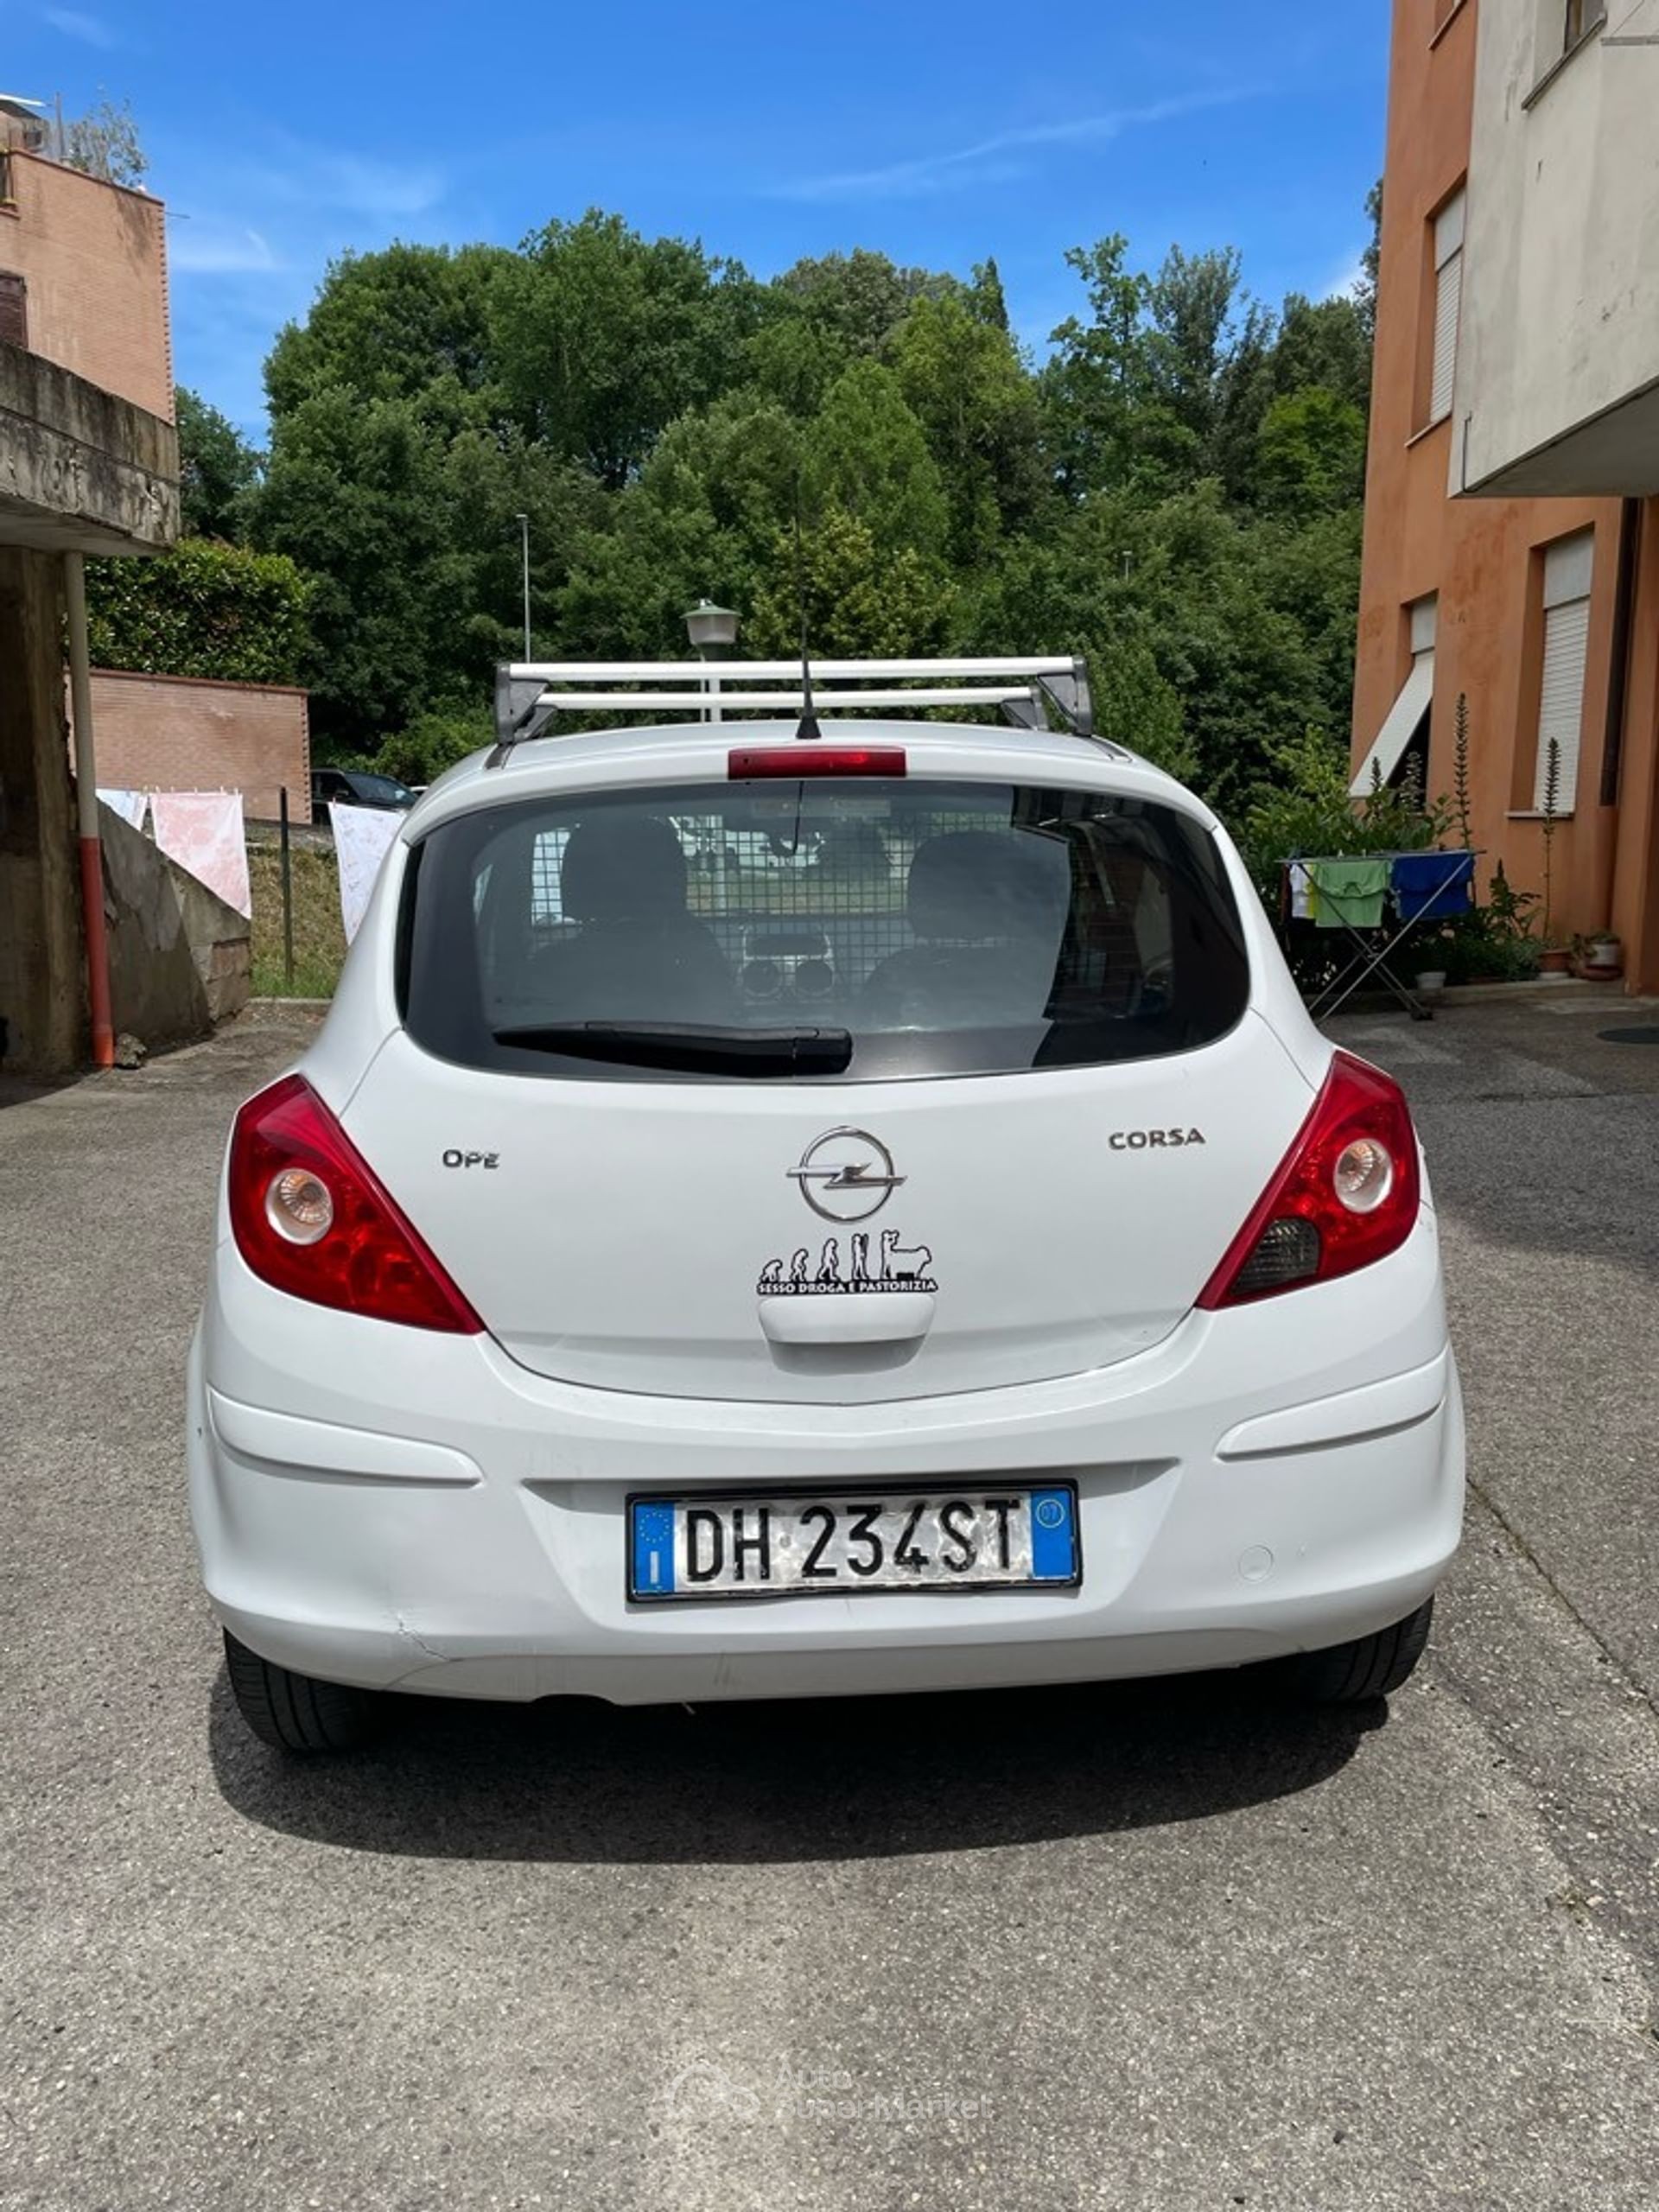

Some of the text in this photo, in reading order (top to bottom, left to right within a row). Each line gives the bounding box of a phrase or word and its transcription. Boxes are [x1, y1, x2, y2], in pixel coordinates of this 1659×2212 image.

[1109, 1127, 1206, 1150] CORSA
[758, 1280, 936, 1294] SESSO DROGA E PASTORIZIA
[686, 1498, 1020, 1582] DH 234ST
